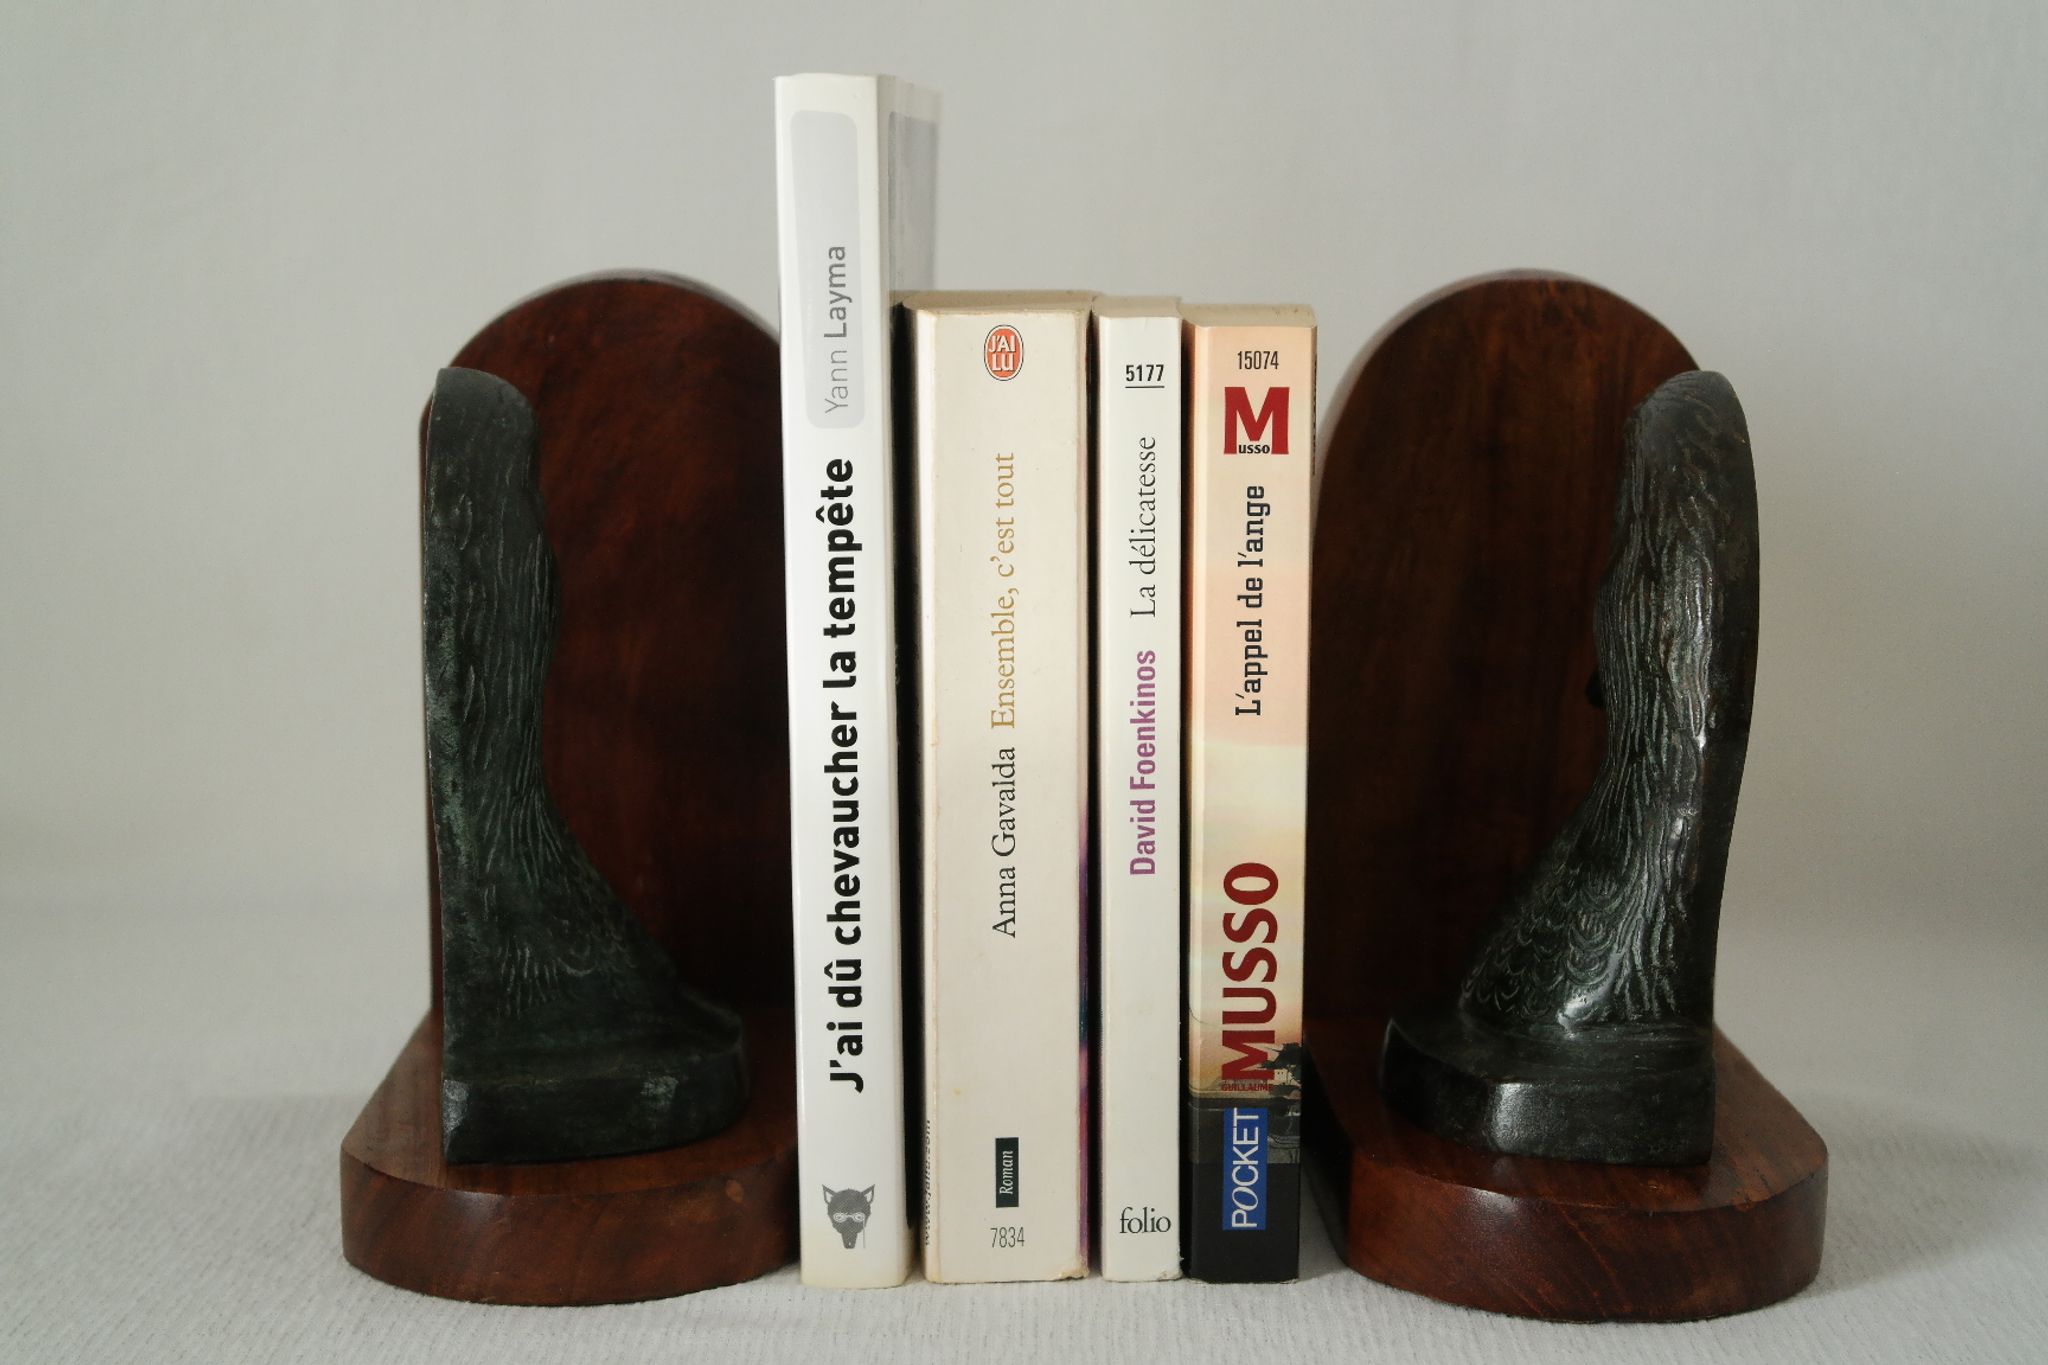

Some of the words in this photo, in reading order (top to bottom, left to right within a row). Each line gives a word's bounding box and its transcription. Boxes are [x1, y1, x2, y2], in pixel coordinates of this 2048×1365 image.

[823, 245, 852, 338] Layma
[988, 335, 1016, 353] J'AI
[991, 353, 1015, 372] LU
[1125, 364, 1165, 382] 5177
[1237, 350, 1279, 370] 15074
[824, 349, 849, 414] Yann
[995, 452, 1015, 509] tout
[1128, 436, 1156, 575] délicatesse
[815, 458, 862, 639] tempête
[989, 516, 1015, 578] c'est
[1237, 485, 1271, 568] l'ange
[1130, 584, 1156, 618] La
[1237, 577, 1264, 608] de
[822, 650, 857, 689] la
[990, 586, 1019, 730] Ensemble,
[1235, 618, 1268, 717] L'appel
[1129, 649, 1156, 790] Foenkinos
[823, 700, 862, 946] chevaucher
[991, 746, 1016, 857] Gavalda
[1129, 799, 1156, 876] David
[991, 866, 1016, 939] Anna
[823, 958, 863, 1008] dû
[1221, 862, 1279, 1081] MUSSO
[826, 1021, 864, 1094] J'ai
[999, 1150, 1014, 1195] Roman
[1231, 1106, 1260, 1229] POCKET
[990, 1226, 1025, 1248] 7834
[1119, 1206, 1172, 1234] folio
